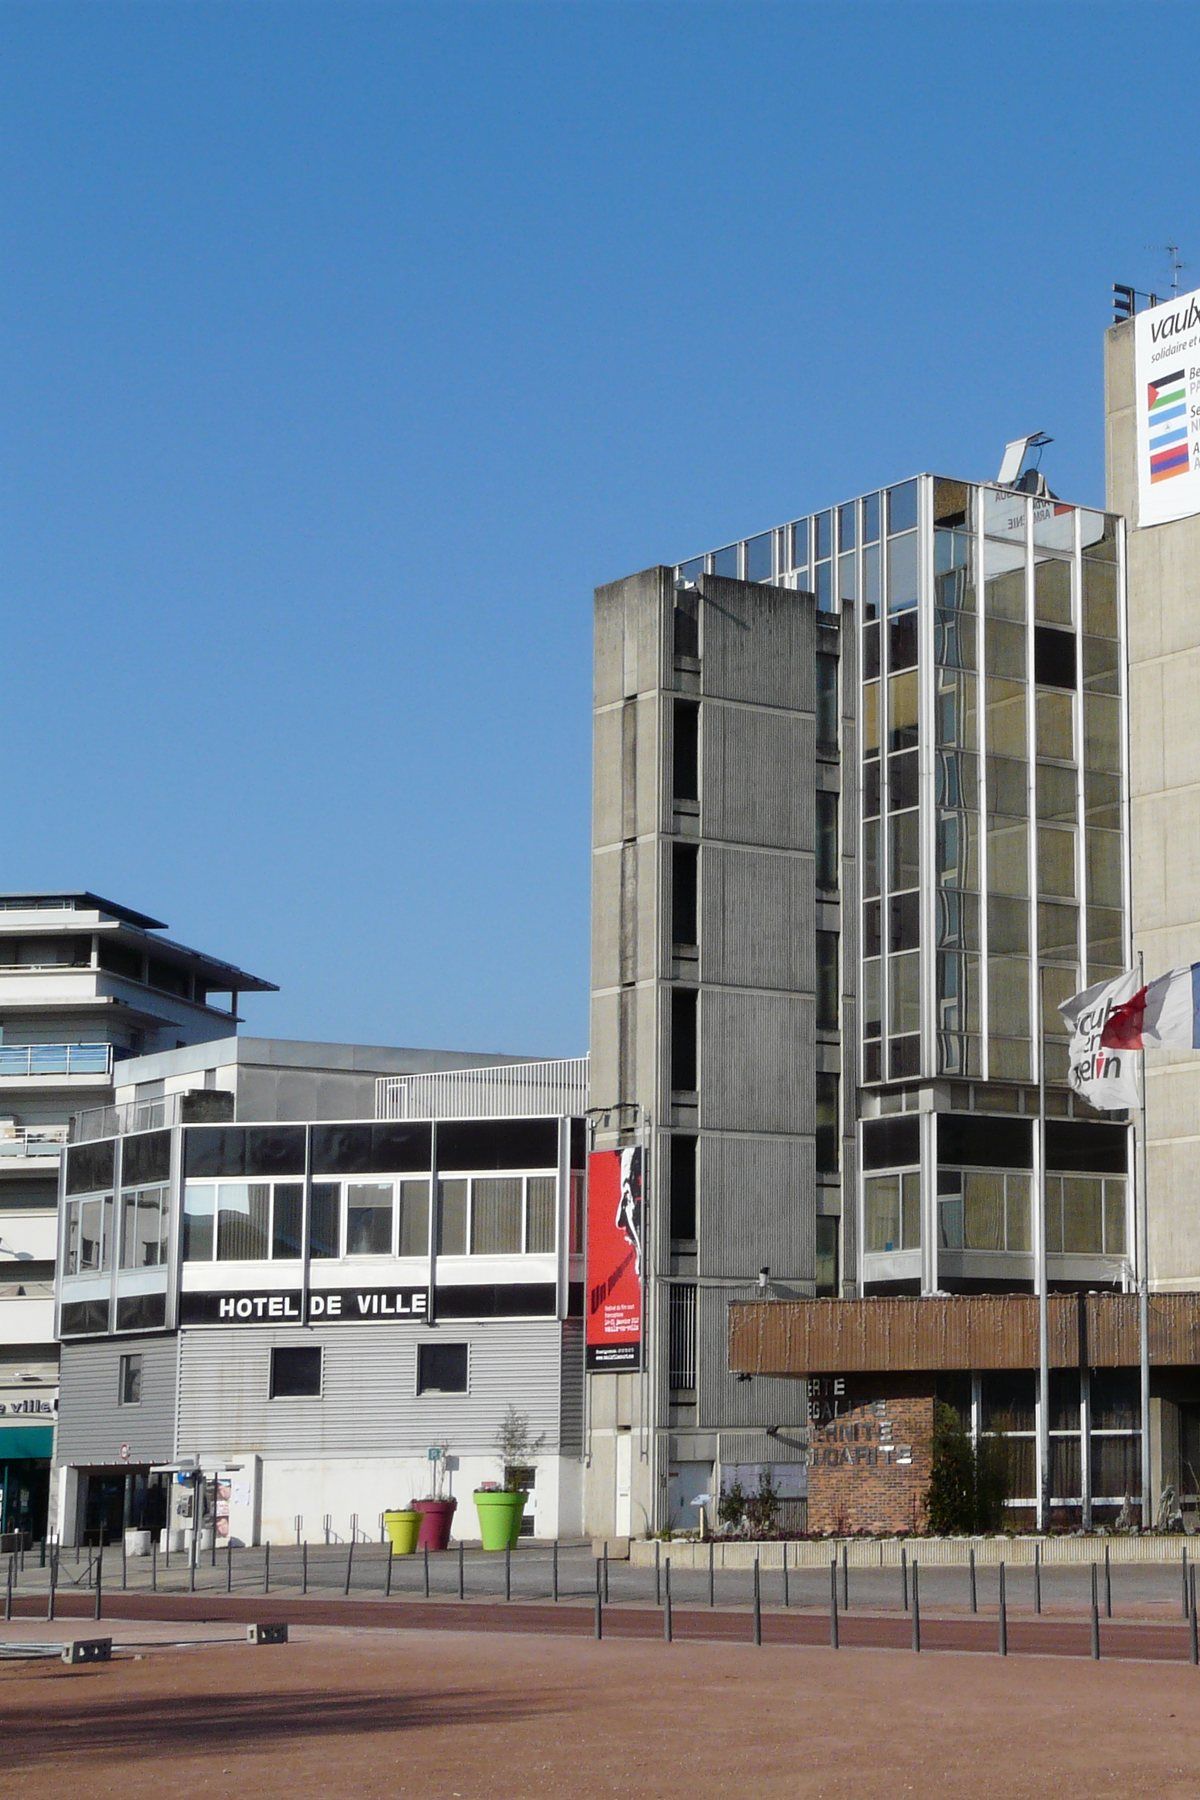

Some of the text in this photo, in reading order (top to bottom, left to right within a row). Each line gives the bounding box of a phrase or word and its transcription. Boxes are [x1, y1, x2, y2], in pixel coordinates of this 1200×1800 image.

[1151, 341, 1189, 363] solidaire
[1189, 335, 1197, 348] et
[219, 1293, 427, 1317] HOTEL DE VILLE
[10, 1399, 51, 1413] ville
